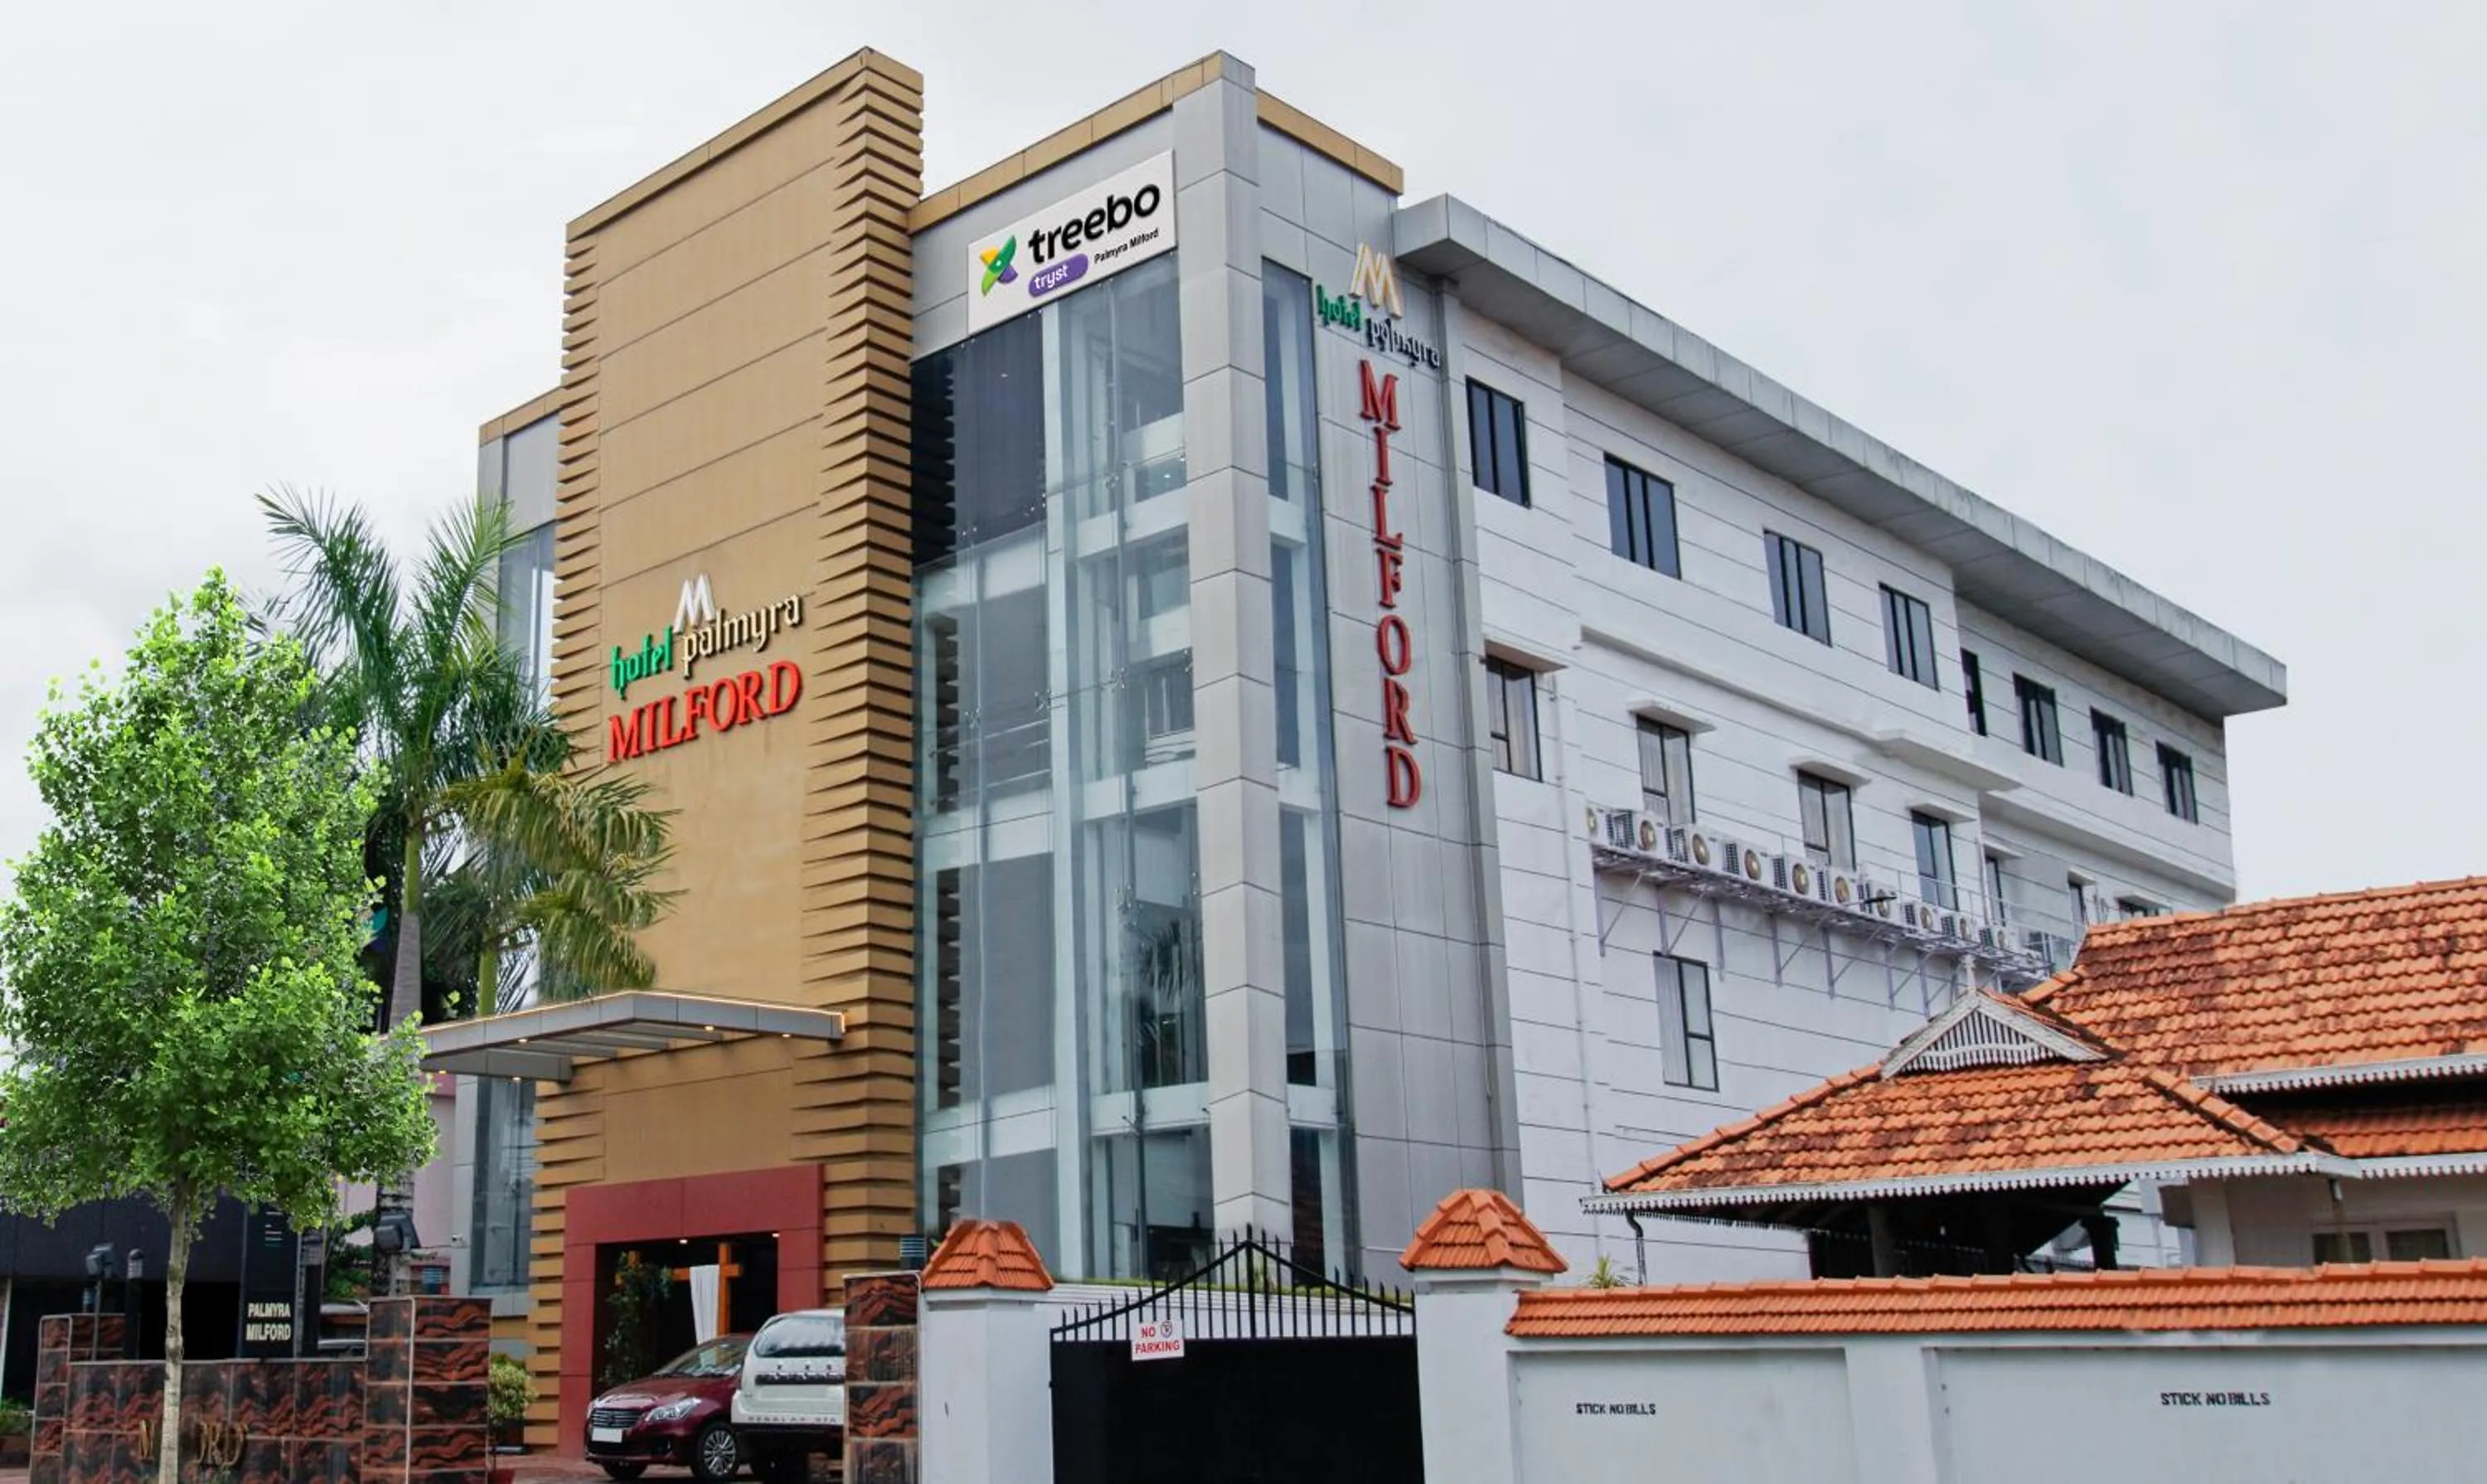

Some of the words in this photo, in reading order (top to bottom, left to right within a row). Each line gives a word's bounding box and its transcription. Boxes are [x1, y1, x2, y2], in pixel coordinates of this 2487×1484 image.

[1028, 184, 1160, 264] treebo
[1094, 243, 1128, 264] Palmyra
[1130, 227, 1160, 248] Milford
[1035, 264, 1069, 289] tryst
[1360, 359, 1423, 808] MILFORD
[610, 625, 675, 701] hotel
[682, 594, 803, 680] palmyra
[608, 660, 803, 764] MILFORD
[248, 1302, 291, 1318] PALMYRA
[245, 1323, 291, 1341] MILFORD
[1141, 1326, 1156, 1338] NO
[1135, 1340, 1180, 1354] PARKING
[1576, 1403, 1606, 1414] STICK
[1609, 1403, 1624, 1414] NO
[2160, 1392, 2203, 1406] STICK
[2205, 1392, 2227, 1407] NO
[2228, 1392, 2271, 1406] BILLS
